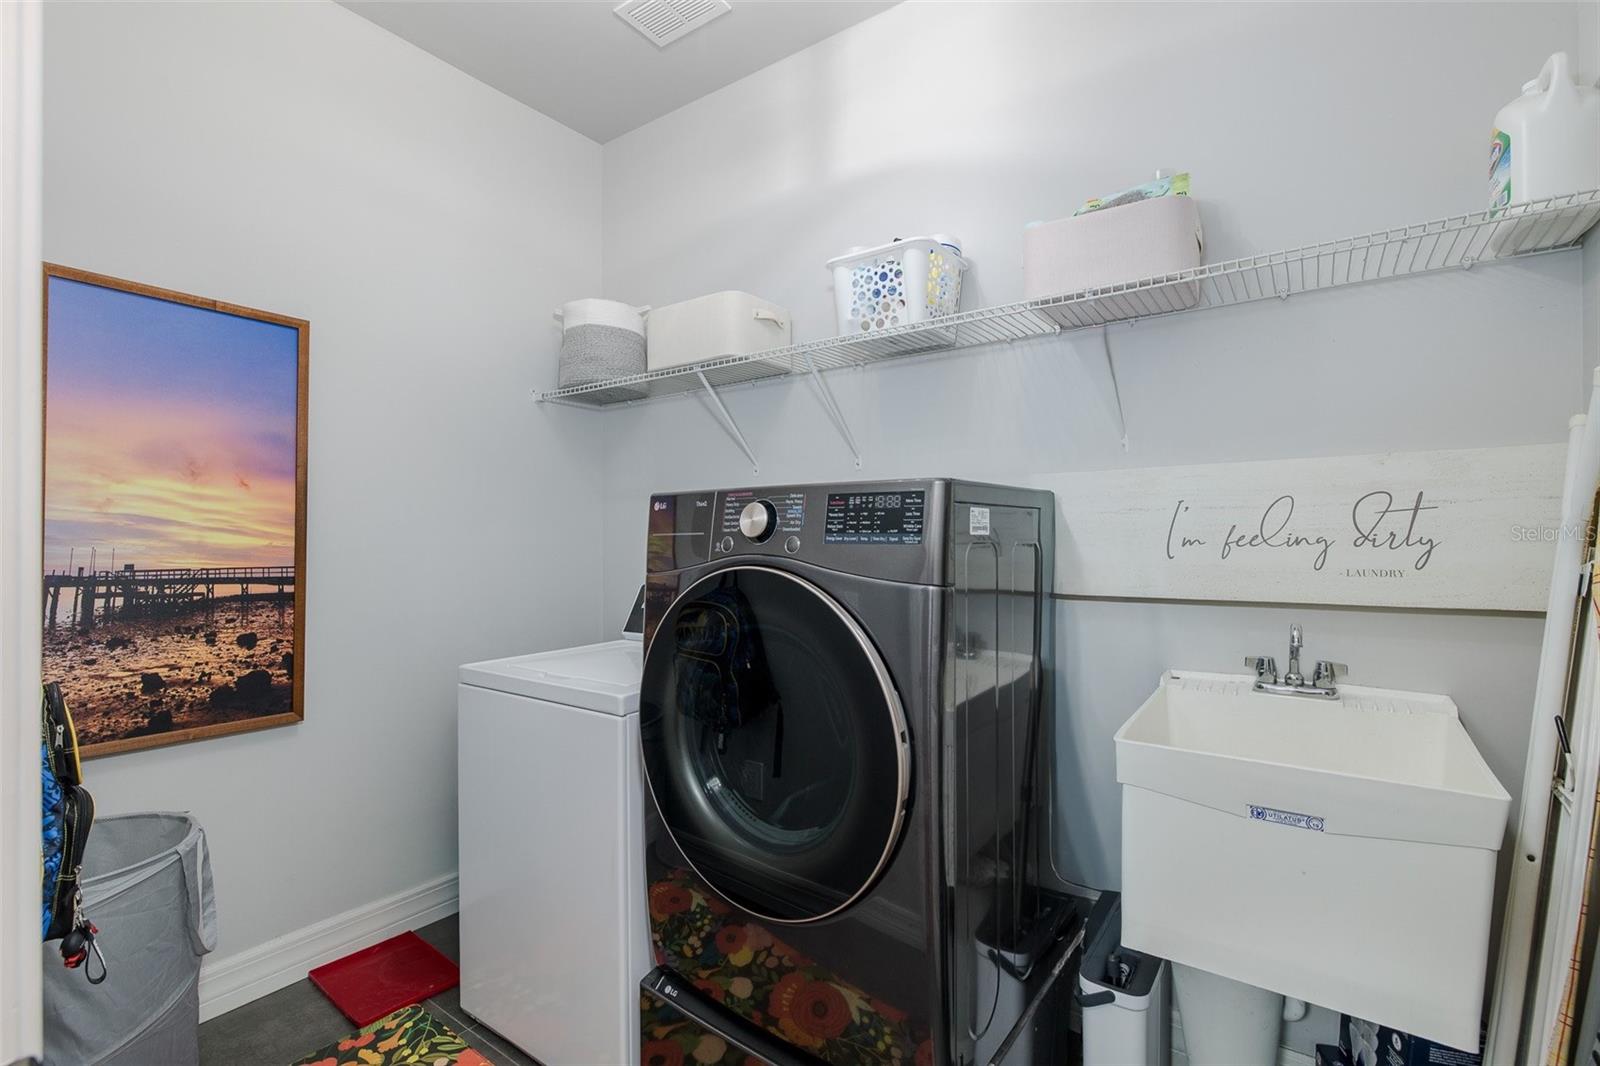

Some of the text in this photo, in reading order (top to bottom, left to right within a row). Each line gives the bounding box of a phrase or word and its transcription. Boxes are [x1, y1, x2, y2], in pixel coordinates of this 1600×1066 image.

[1166, 490, 1441, 570] I'm feeling dirty
[1346, 568, 1406, 578] LAUNDRY
